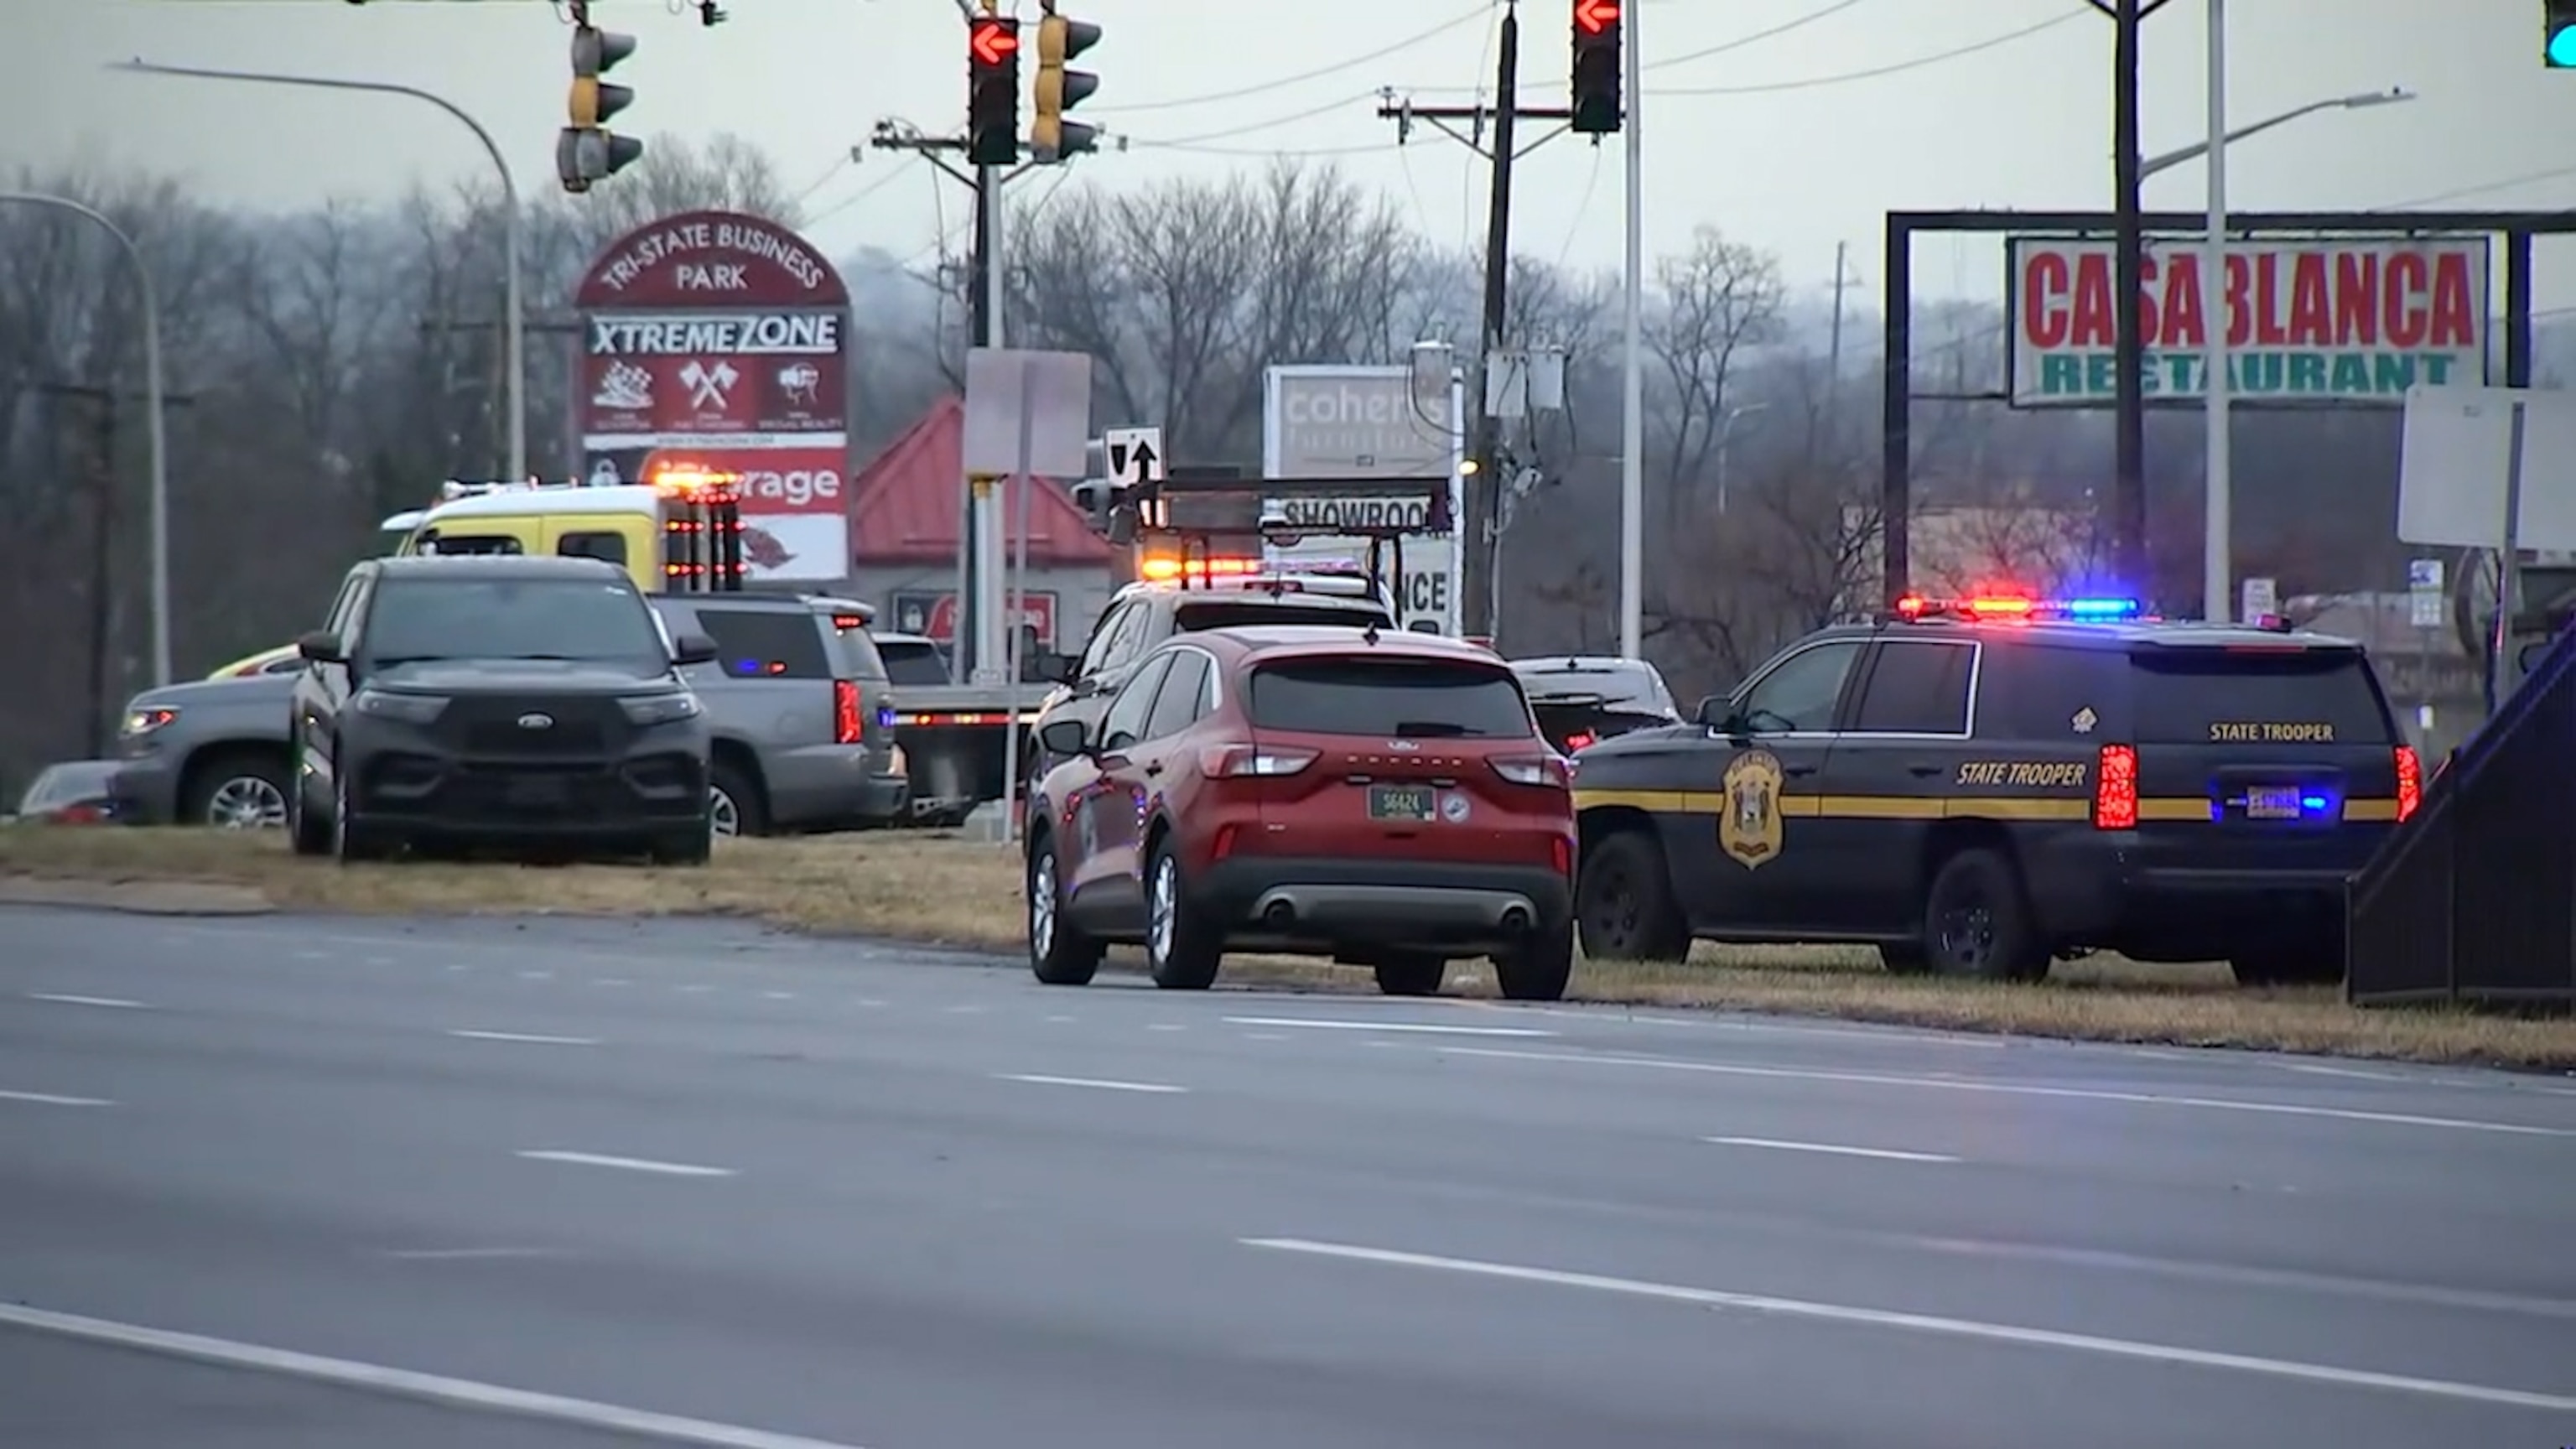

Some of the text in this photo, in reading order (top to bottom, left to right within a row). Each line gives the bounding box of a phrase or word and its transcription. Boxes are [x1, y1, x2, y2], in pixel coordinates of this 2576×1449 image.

[602, 223, 825, 291] TRI-STATE BUSINESS
[676, 264, 749, 289] PARK
[1285, 385, 1445, 424] cohens
[1284, 501, 1431, 528] SHOWROO
[2210, 723, 2334, 742] STATE TROOPER
[1956, 763, 2087, 787] STATE TROOPER
